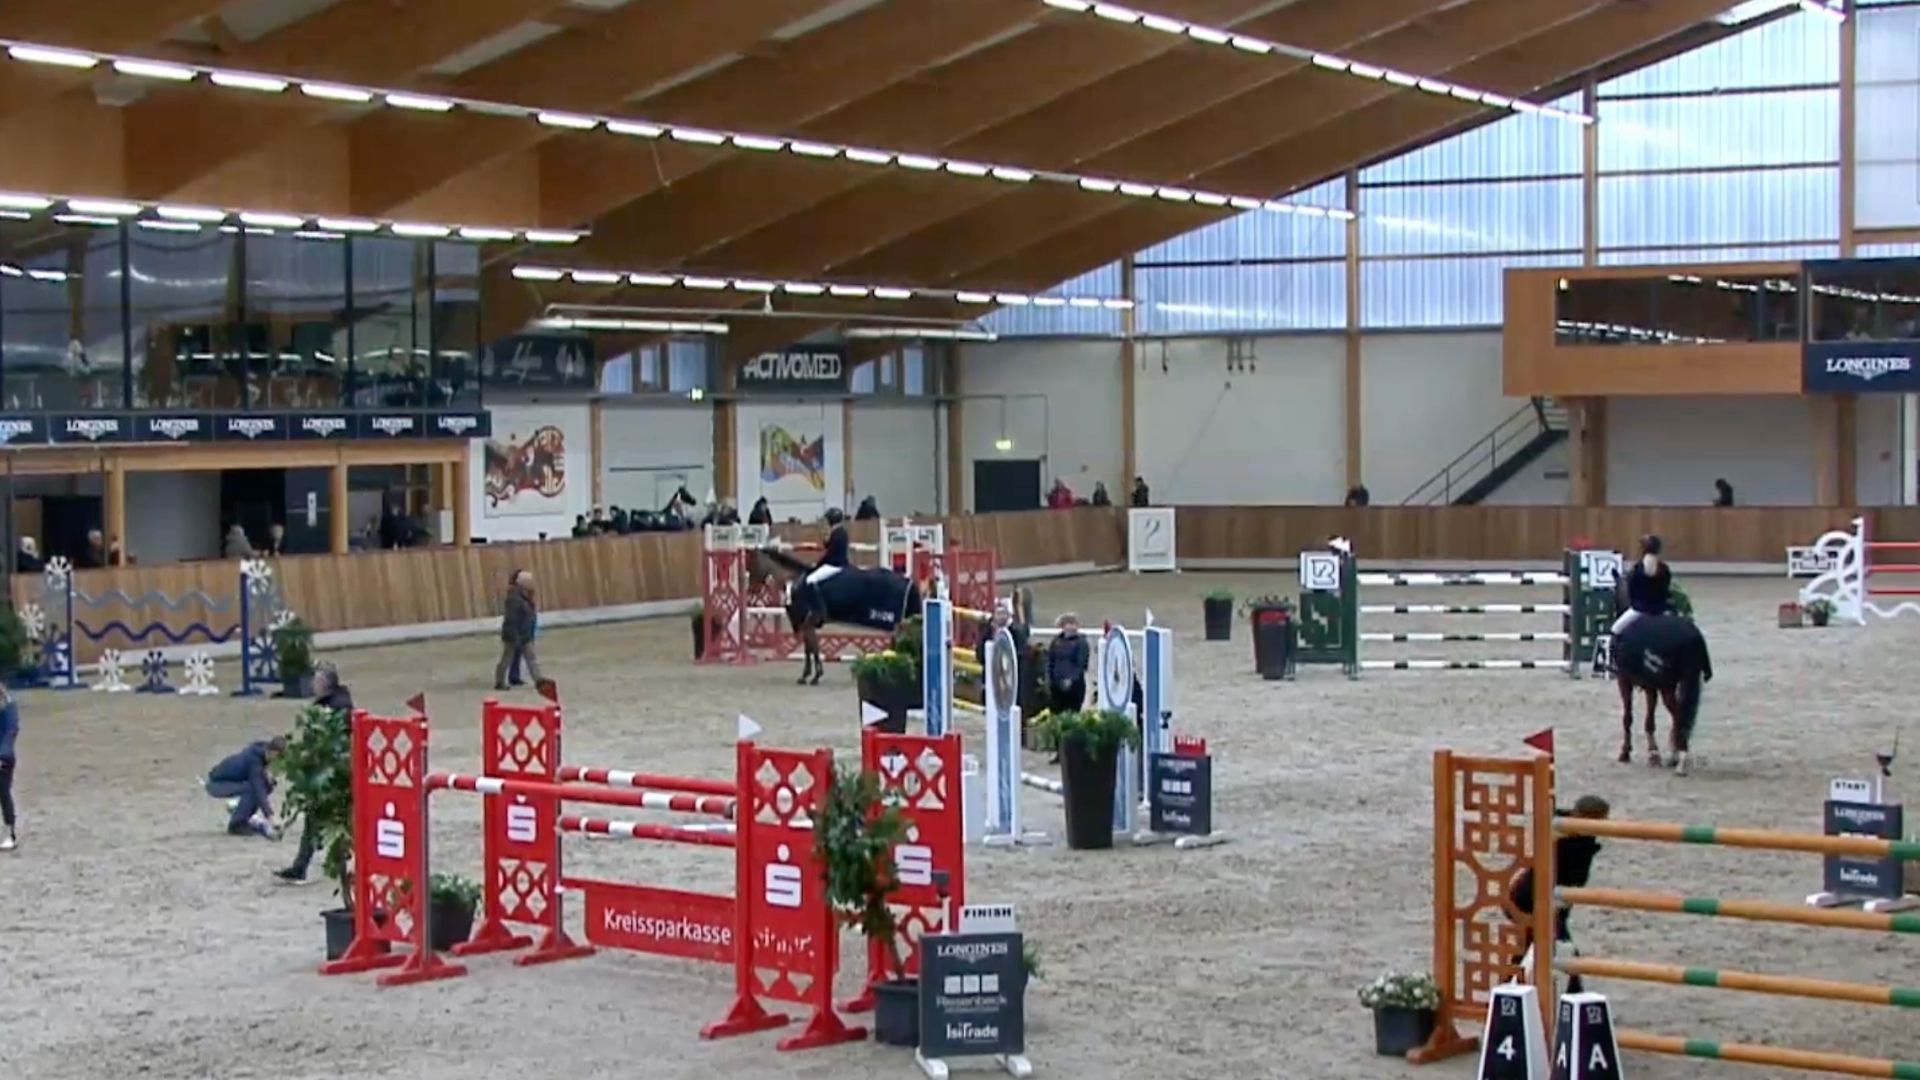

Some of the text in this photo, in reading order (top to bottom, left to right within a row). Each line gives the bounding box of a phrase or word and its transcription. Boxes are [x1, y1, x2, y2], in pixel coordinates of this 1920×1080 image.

[743, 353, 842, 379] ACTIVOMED
[1825, 358, 1911, 372] LONGINES
[66, 420, 119, 432] LONGINES
[964, 908, 1011, 918] FINISH
[604, 908, 732, 945] Kreissparkasse
[937, 942, 1008, 957] LONGINES
[1497, 1035, 1515, 1060] 4
[1588, 1043, 1608, 1070] A
